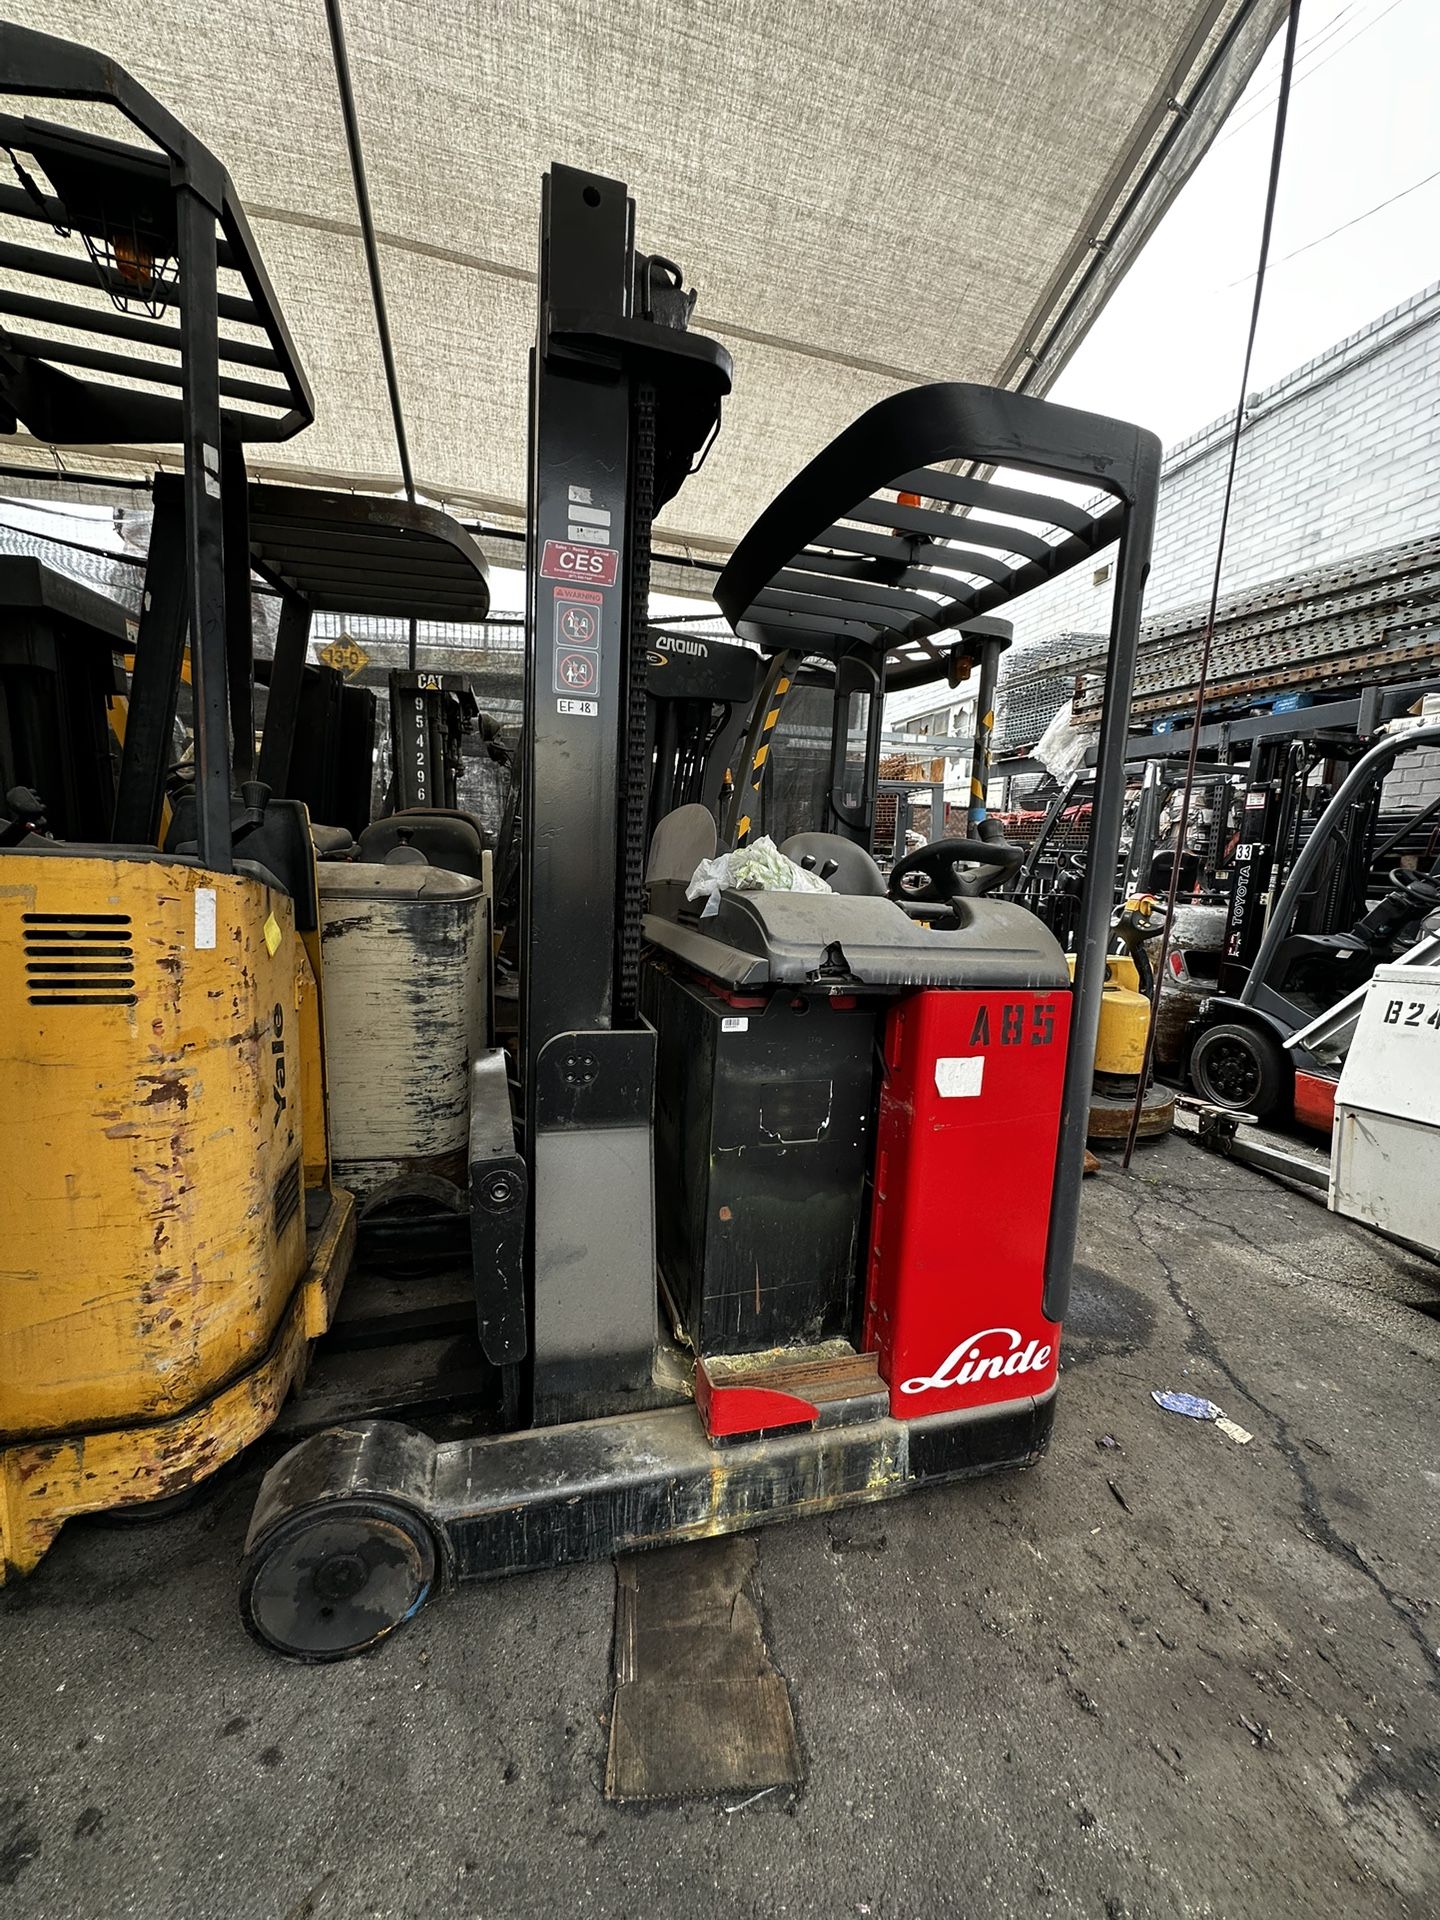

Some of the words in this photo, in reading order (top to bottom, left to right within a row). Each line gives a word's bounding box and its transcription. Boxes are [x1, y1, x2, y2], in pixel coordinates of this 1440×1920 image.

[560, 552, 603, 573] CES
[564, 590, 601, 602] WARNING
[417, 674, 443, 690] CAT
[1237, 845, 1251, 859] 33
[1232, 865, 1251, 926] TOYOTA
[271, 1003, 286, 1128] Yale
[900, 1328, 1051, 1394] Linde
